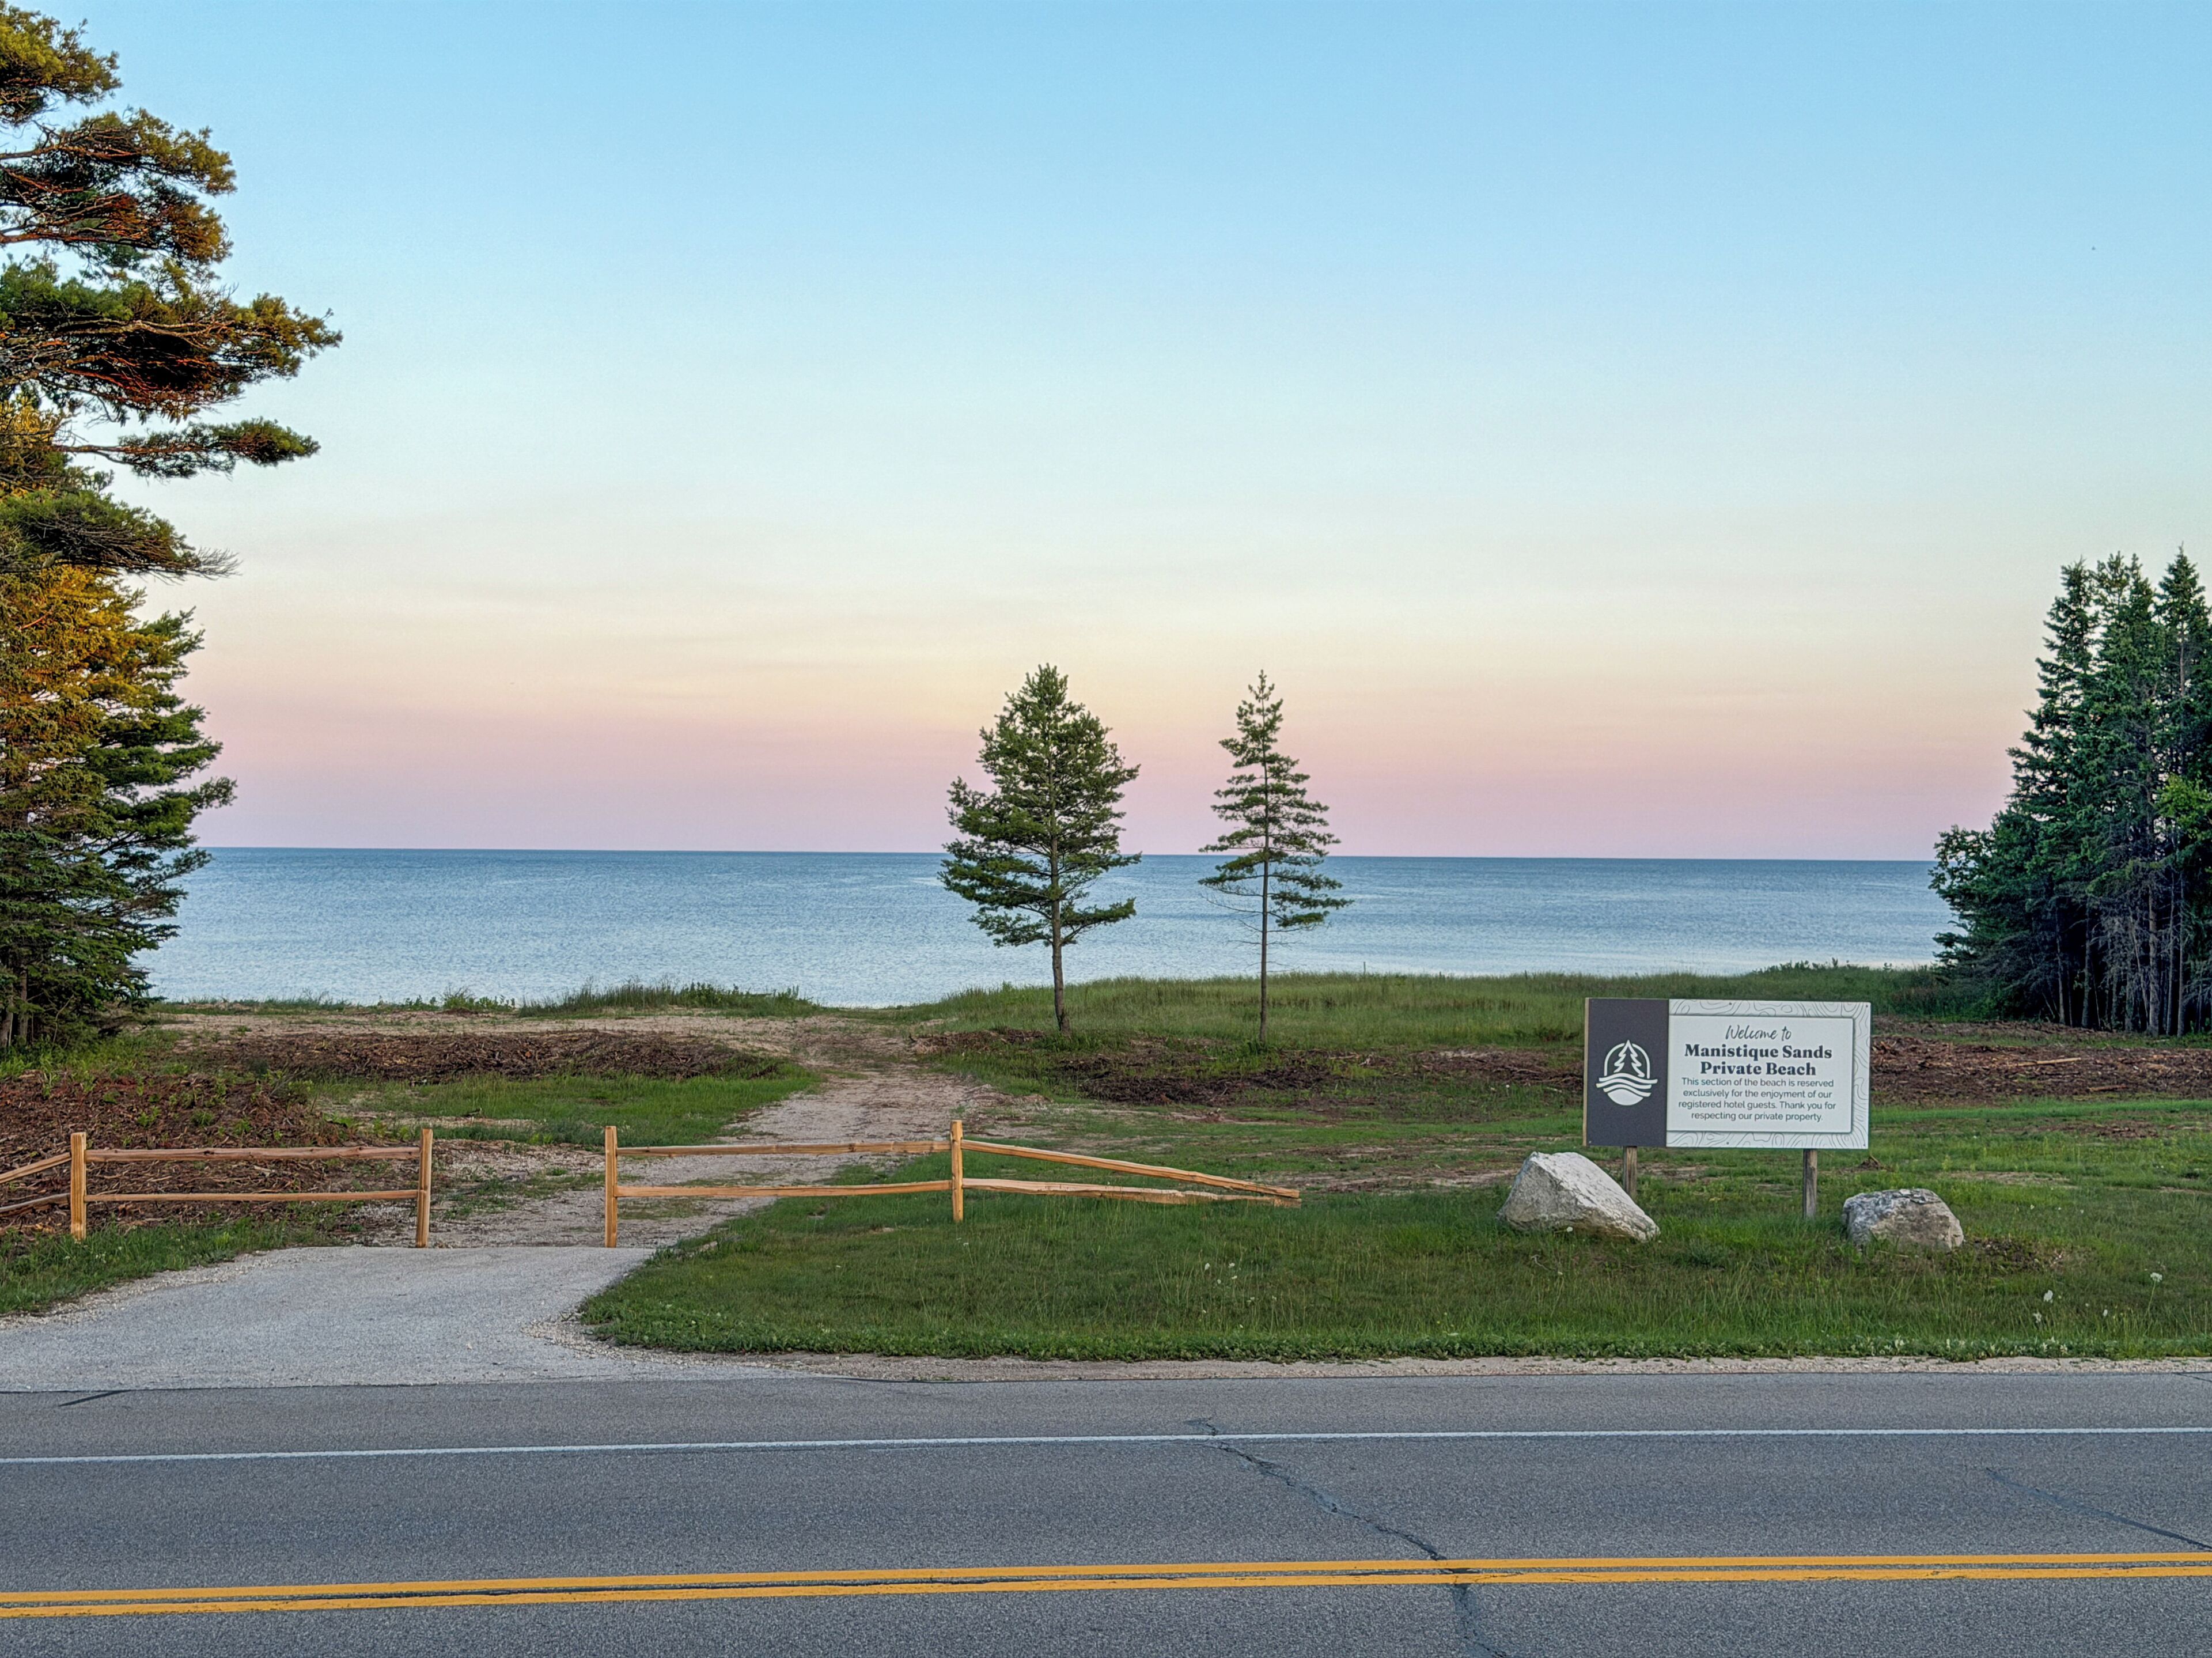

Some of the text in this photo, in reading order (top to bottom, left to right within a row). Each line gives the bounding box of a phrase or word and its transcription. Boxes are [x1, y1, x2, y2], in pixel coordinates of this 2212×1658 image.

[1726, 1025, 1791, 1041] Welcome to
[1685, 1044, 1832, 1061] Manistique Sands
[1700, 1061, 1816, 1075] Private Beach
[1683, 1089, 1729, 1099] exclusively
[1761, 1091, 1805, 1099] enjoyment
[1679, 1101, 1721, 1110] registered
[1747, 1101, 1777, 1110] guests.
[1692, 1112, 1736, 1121] respecting
[1755, 1113, 1783, 1121] private
[1786, 1114, 1823, 1122] property.
